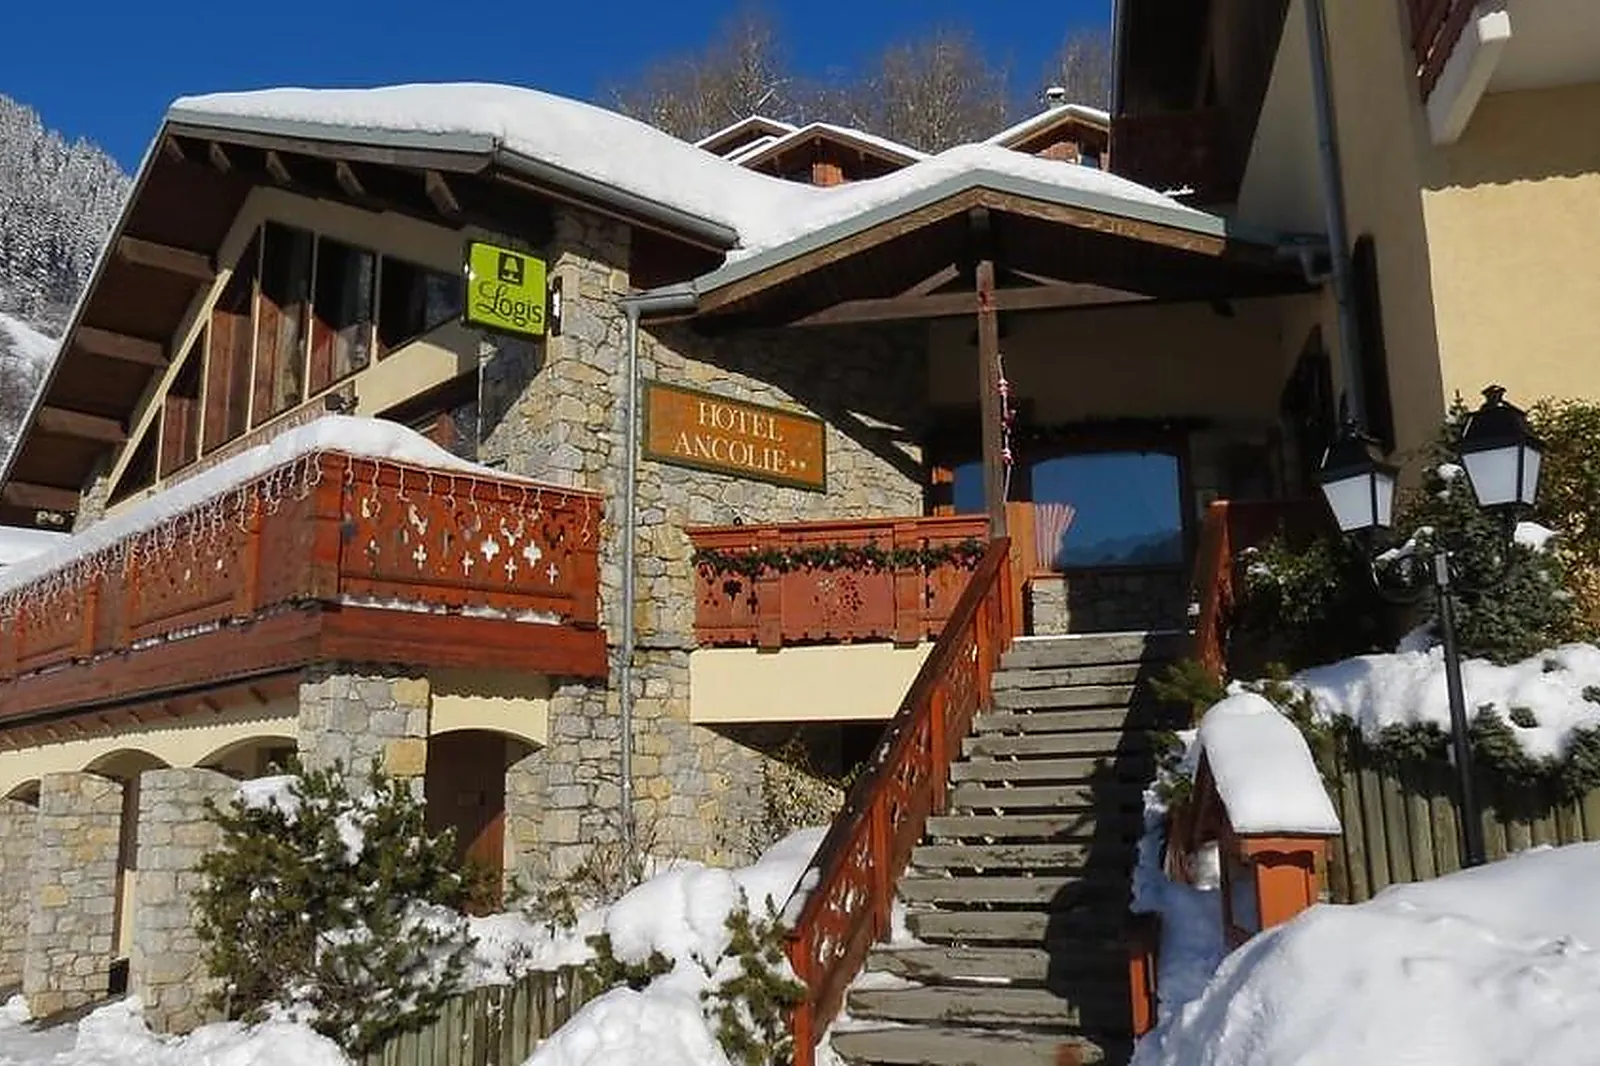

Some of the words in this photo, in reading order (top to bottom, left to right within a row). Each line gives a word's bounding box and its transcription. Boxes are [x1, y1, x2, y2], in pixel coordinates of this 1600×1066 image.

[475, 280, 542, 327] Logis
[699, 402, 783, 442] HOTEL
[674, 431, 788, 474] ANCOLIE
